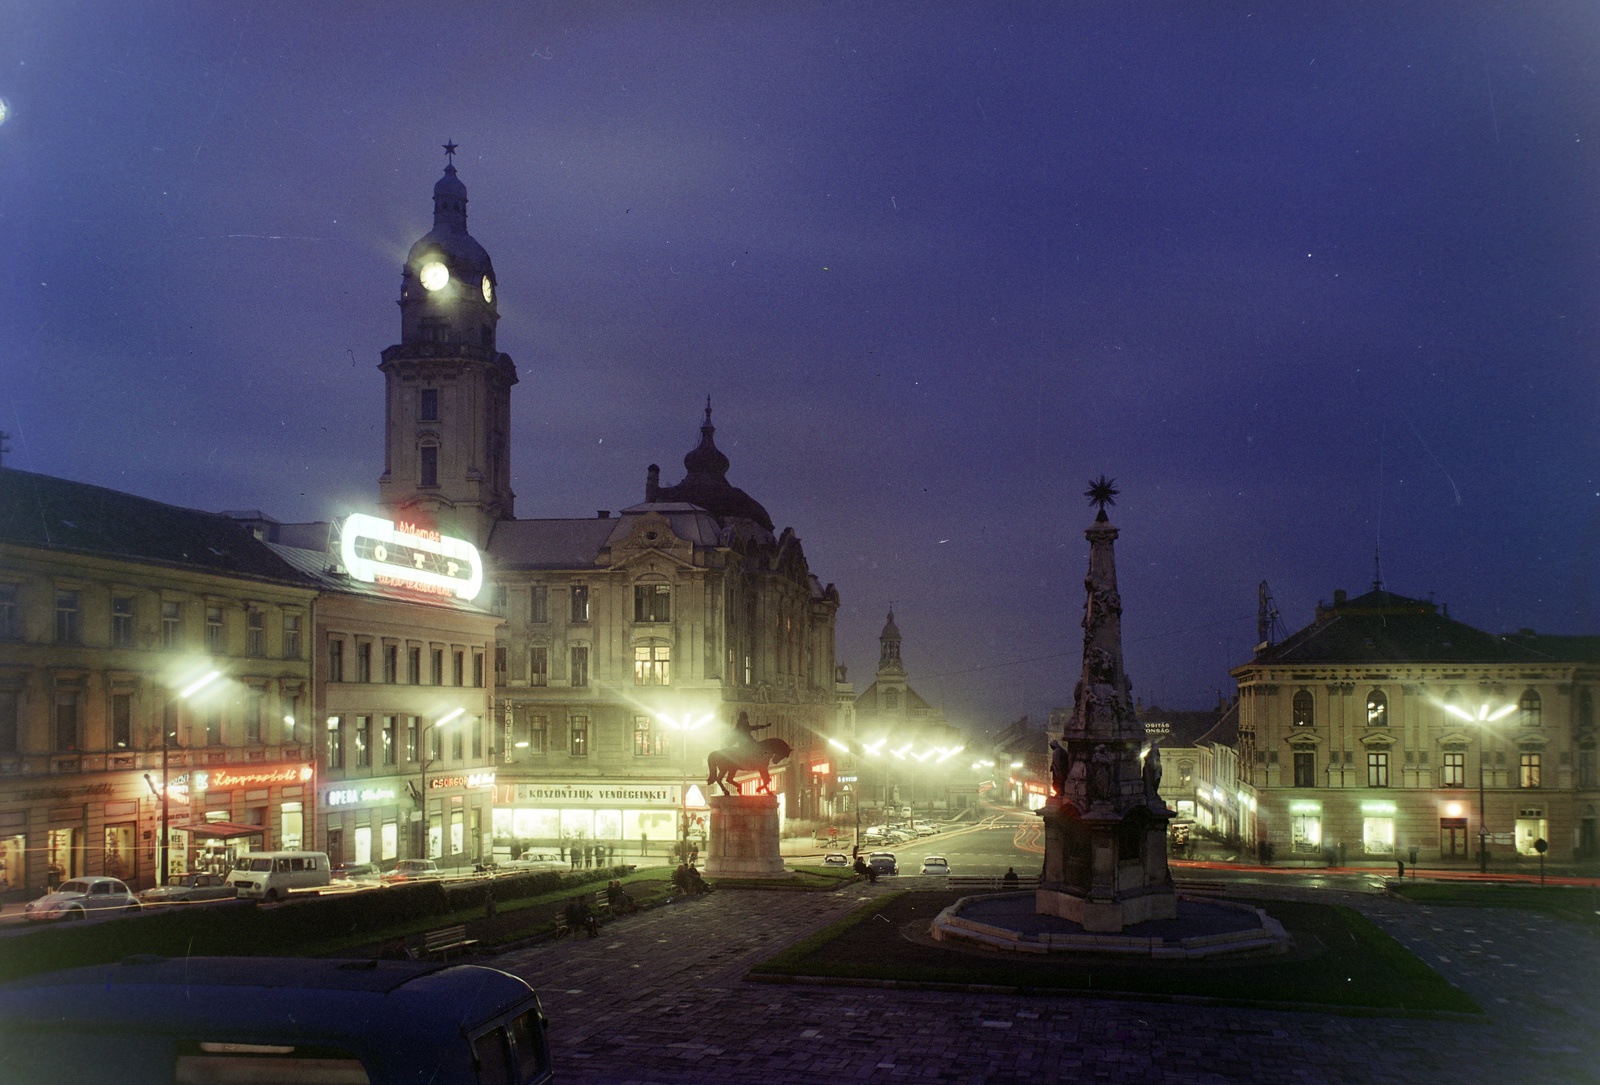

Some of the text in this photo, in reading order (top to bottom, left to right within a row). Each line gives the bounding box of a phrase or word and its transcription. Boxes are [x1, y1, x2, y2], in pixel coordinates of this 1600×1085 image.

[374, 545, 460, 577] OTP
[329, 789, 358, 806] OPERA
[599, 788, 667, 800] VENDÉGEINKET
